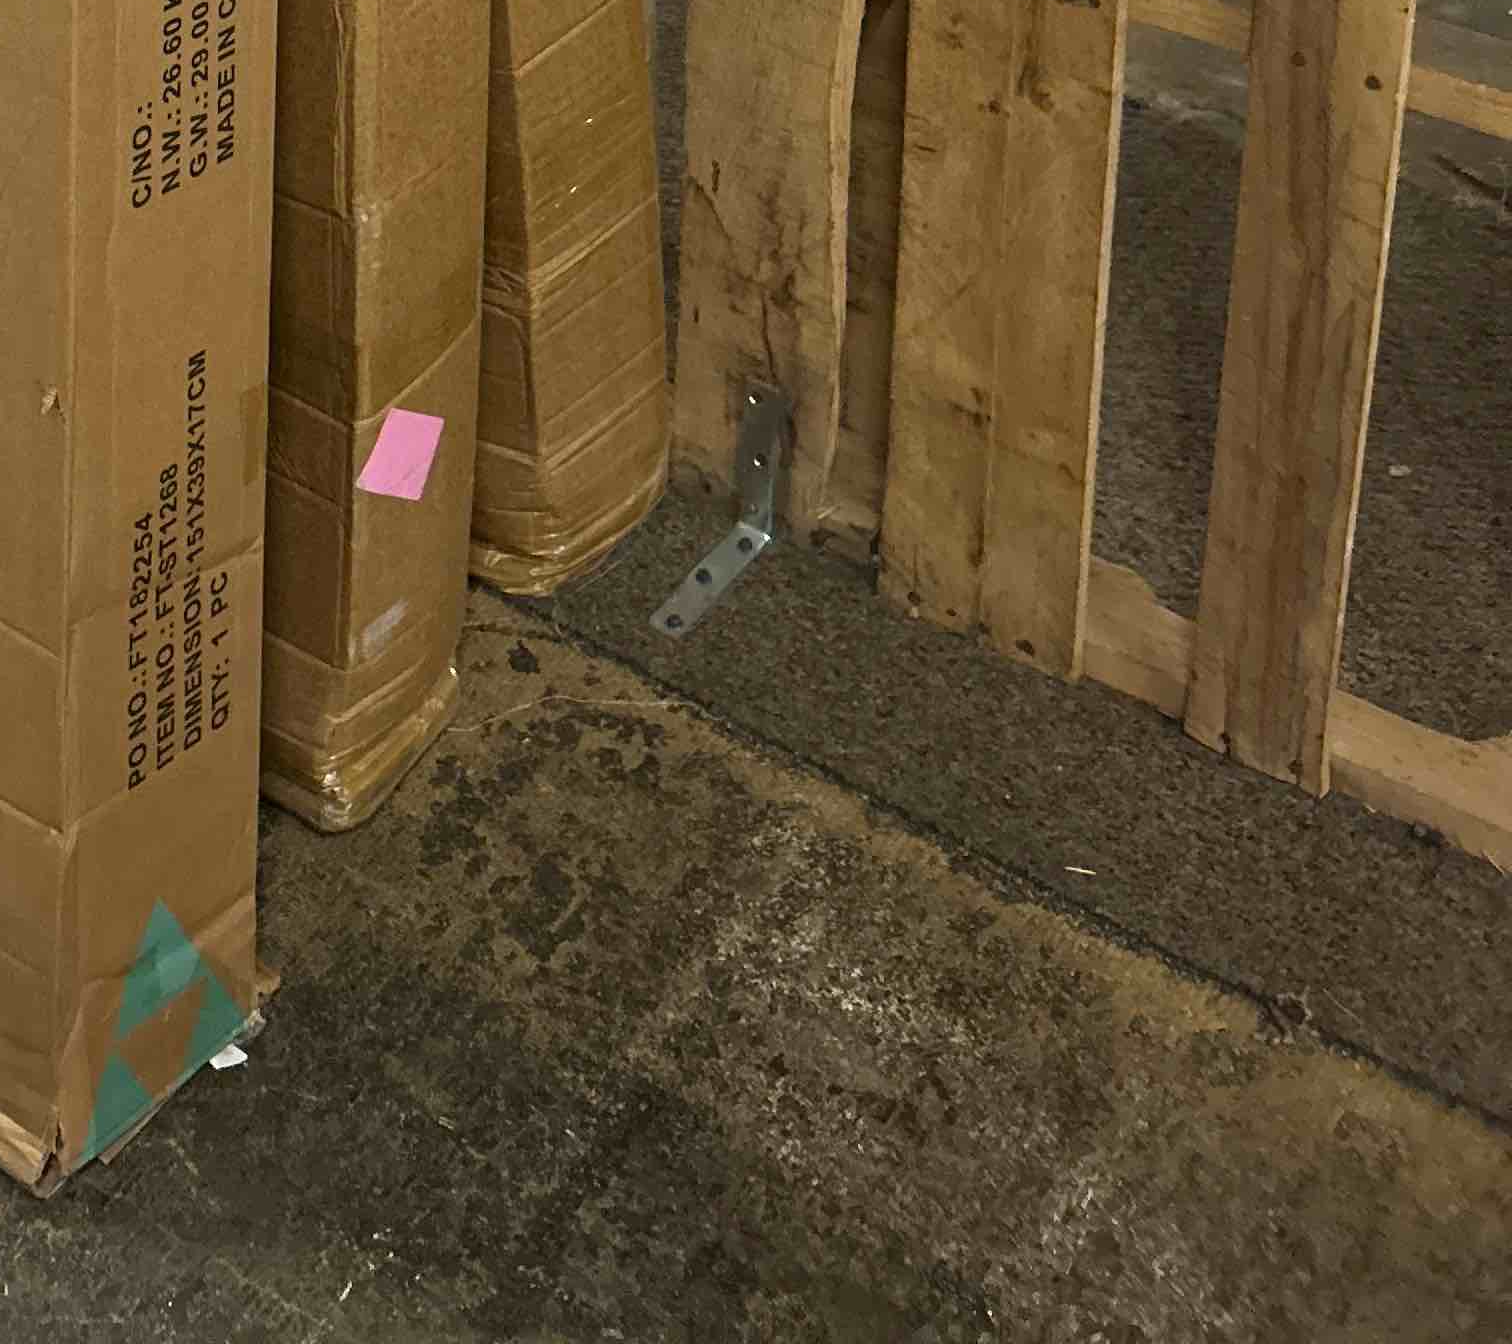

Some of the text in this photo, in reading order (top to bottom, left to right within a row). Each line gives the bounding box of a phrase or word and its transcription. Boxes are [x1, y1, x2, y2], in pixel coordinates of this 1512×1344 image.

[162, 16, 184, 103] 26.60
[190, 2, 211, 86] 29.00
[218, 25, 238, 60] IN
[161, 111, 184, 194] N.W.:
[189, 94, 211, 179] G.W.:
[217, 63, 238, 164] MADE
[156, 462, 180, 772] ITEM NO.: FT-ST1268
[211, 571, 231, 731] QTY: 1 PC
[128, 744, 147, 792] PO
